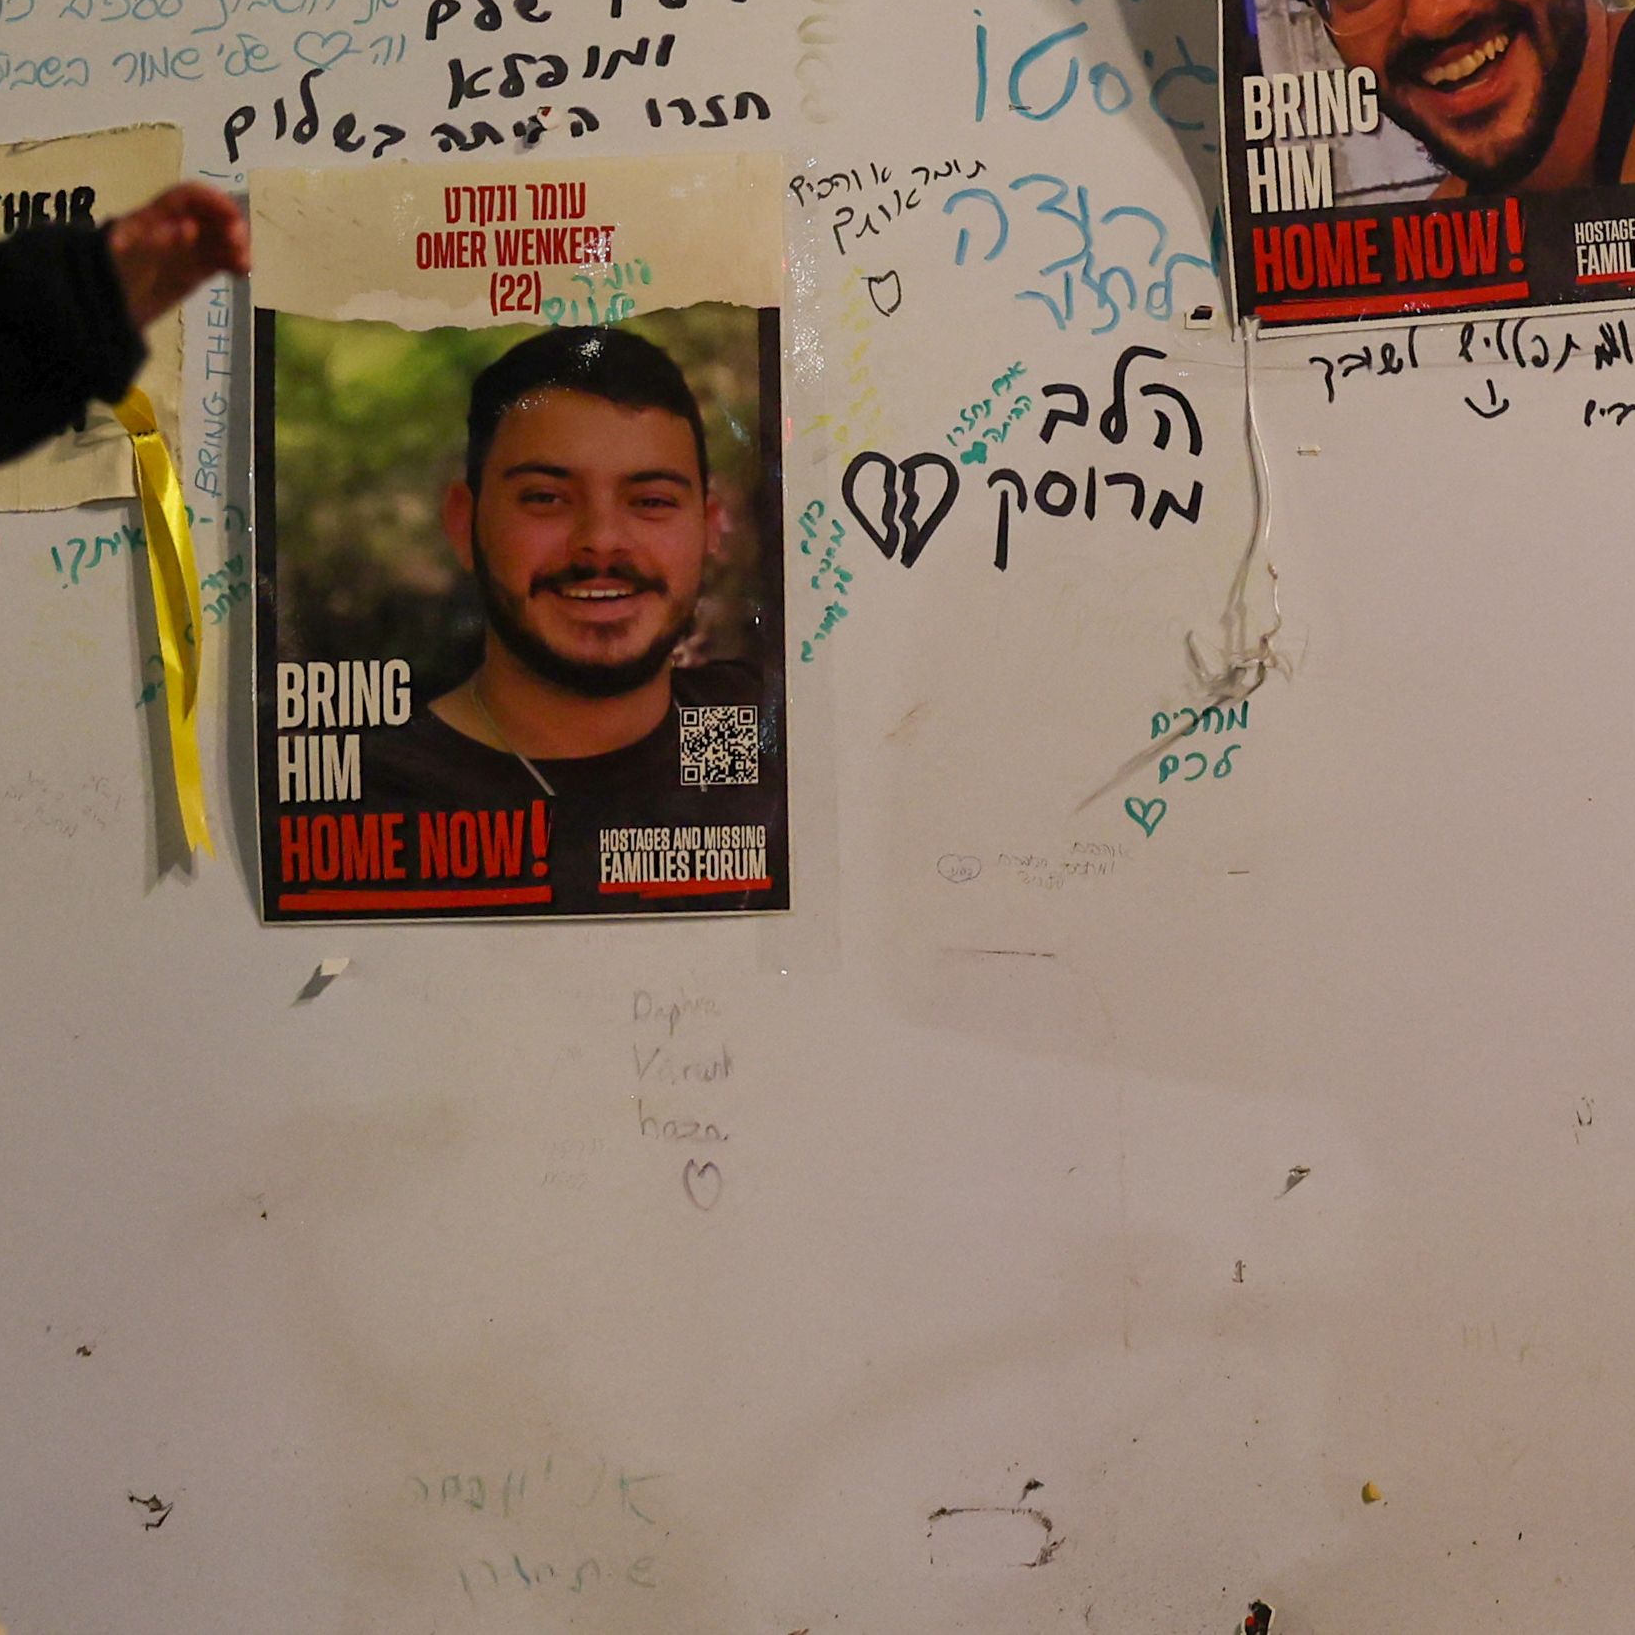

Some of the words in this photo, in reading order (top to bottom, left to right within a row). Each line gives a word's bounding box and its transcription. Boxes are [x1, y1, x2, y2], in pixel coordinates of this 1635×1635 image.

[445, 185, 516, 227] ונקרט
[525, 182, 585, 220] עומר
[417, 231, 486, 269] OMER
[495, 226, 615, 266] WENKERT
[490, 271, 541, 315] (22)
[206, 287, 230, 382] THEM
[1040, 346, 1202, 456] הלב
[195, 398, 226, 497] BRING
[987, 466, 1203, 571] מרוסק
